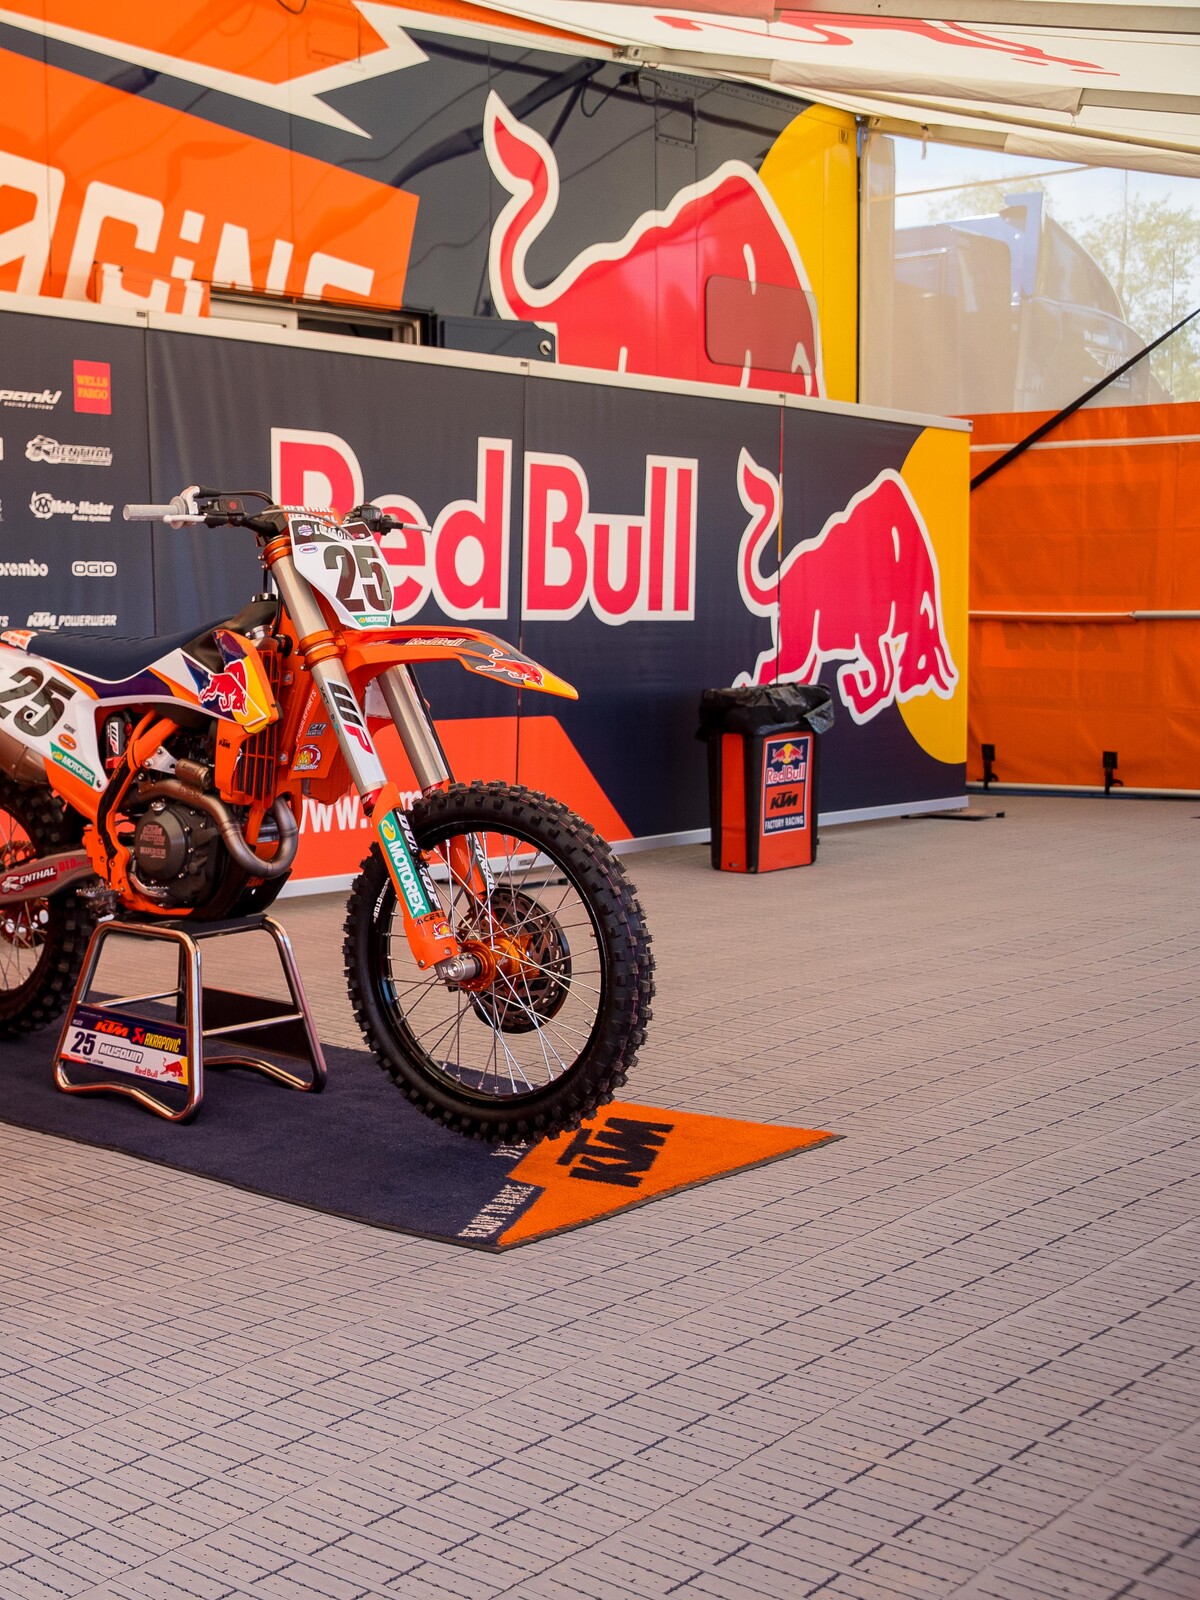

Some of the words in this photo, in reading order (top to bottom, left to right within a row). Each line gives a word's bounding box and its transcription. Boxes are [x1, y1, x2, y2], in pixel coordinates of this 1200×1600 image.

[76, 374, 109, 388] WELLS
[76, 387, 109, 400] FARGO
[523, 451, 699, 625] Bull
[74, 563, 115, 574] OGIO
[323, 545, 392, 611] 25
[26, 612, 56, 628] KTM
[58, 614, 118, 628] POWERWEAR
[327, 681, 375, 755] WP
[62, 755, 95, 783] MOTOREX
[766, 766, 788, 784] Red
[786, 762, 806, 781] Bull
[770, 791, 798, 810] KTM
[765, 818, 784, 830] FACTORY
[785, 815, 804, 827] RACING
[397, 811, 442, 910] DULOP
[388, 840, 427, 915] MOTOREX
[94, 1020, 130, 1037] KTM
[70, 1031, 97, 1056] 25
[99, 1043, 143, 1063] MUSQUIN
[135, 1065, 148, 1076] Red
[146, 1067, 158, 1078] Bull
[557, 1117, 675, 1188] KTM
